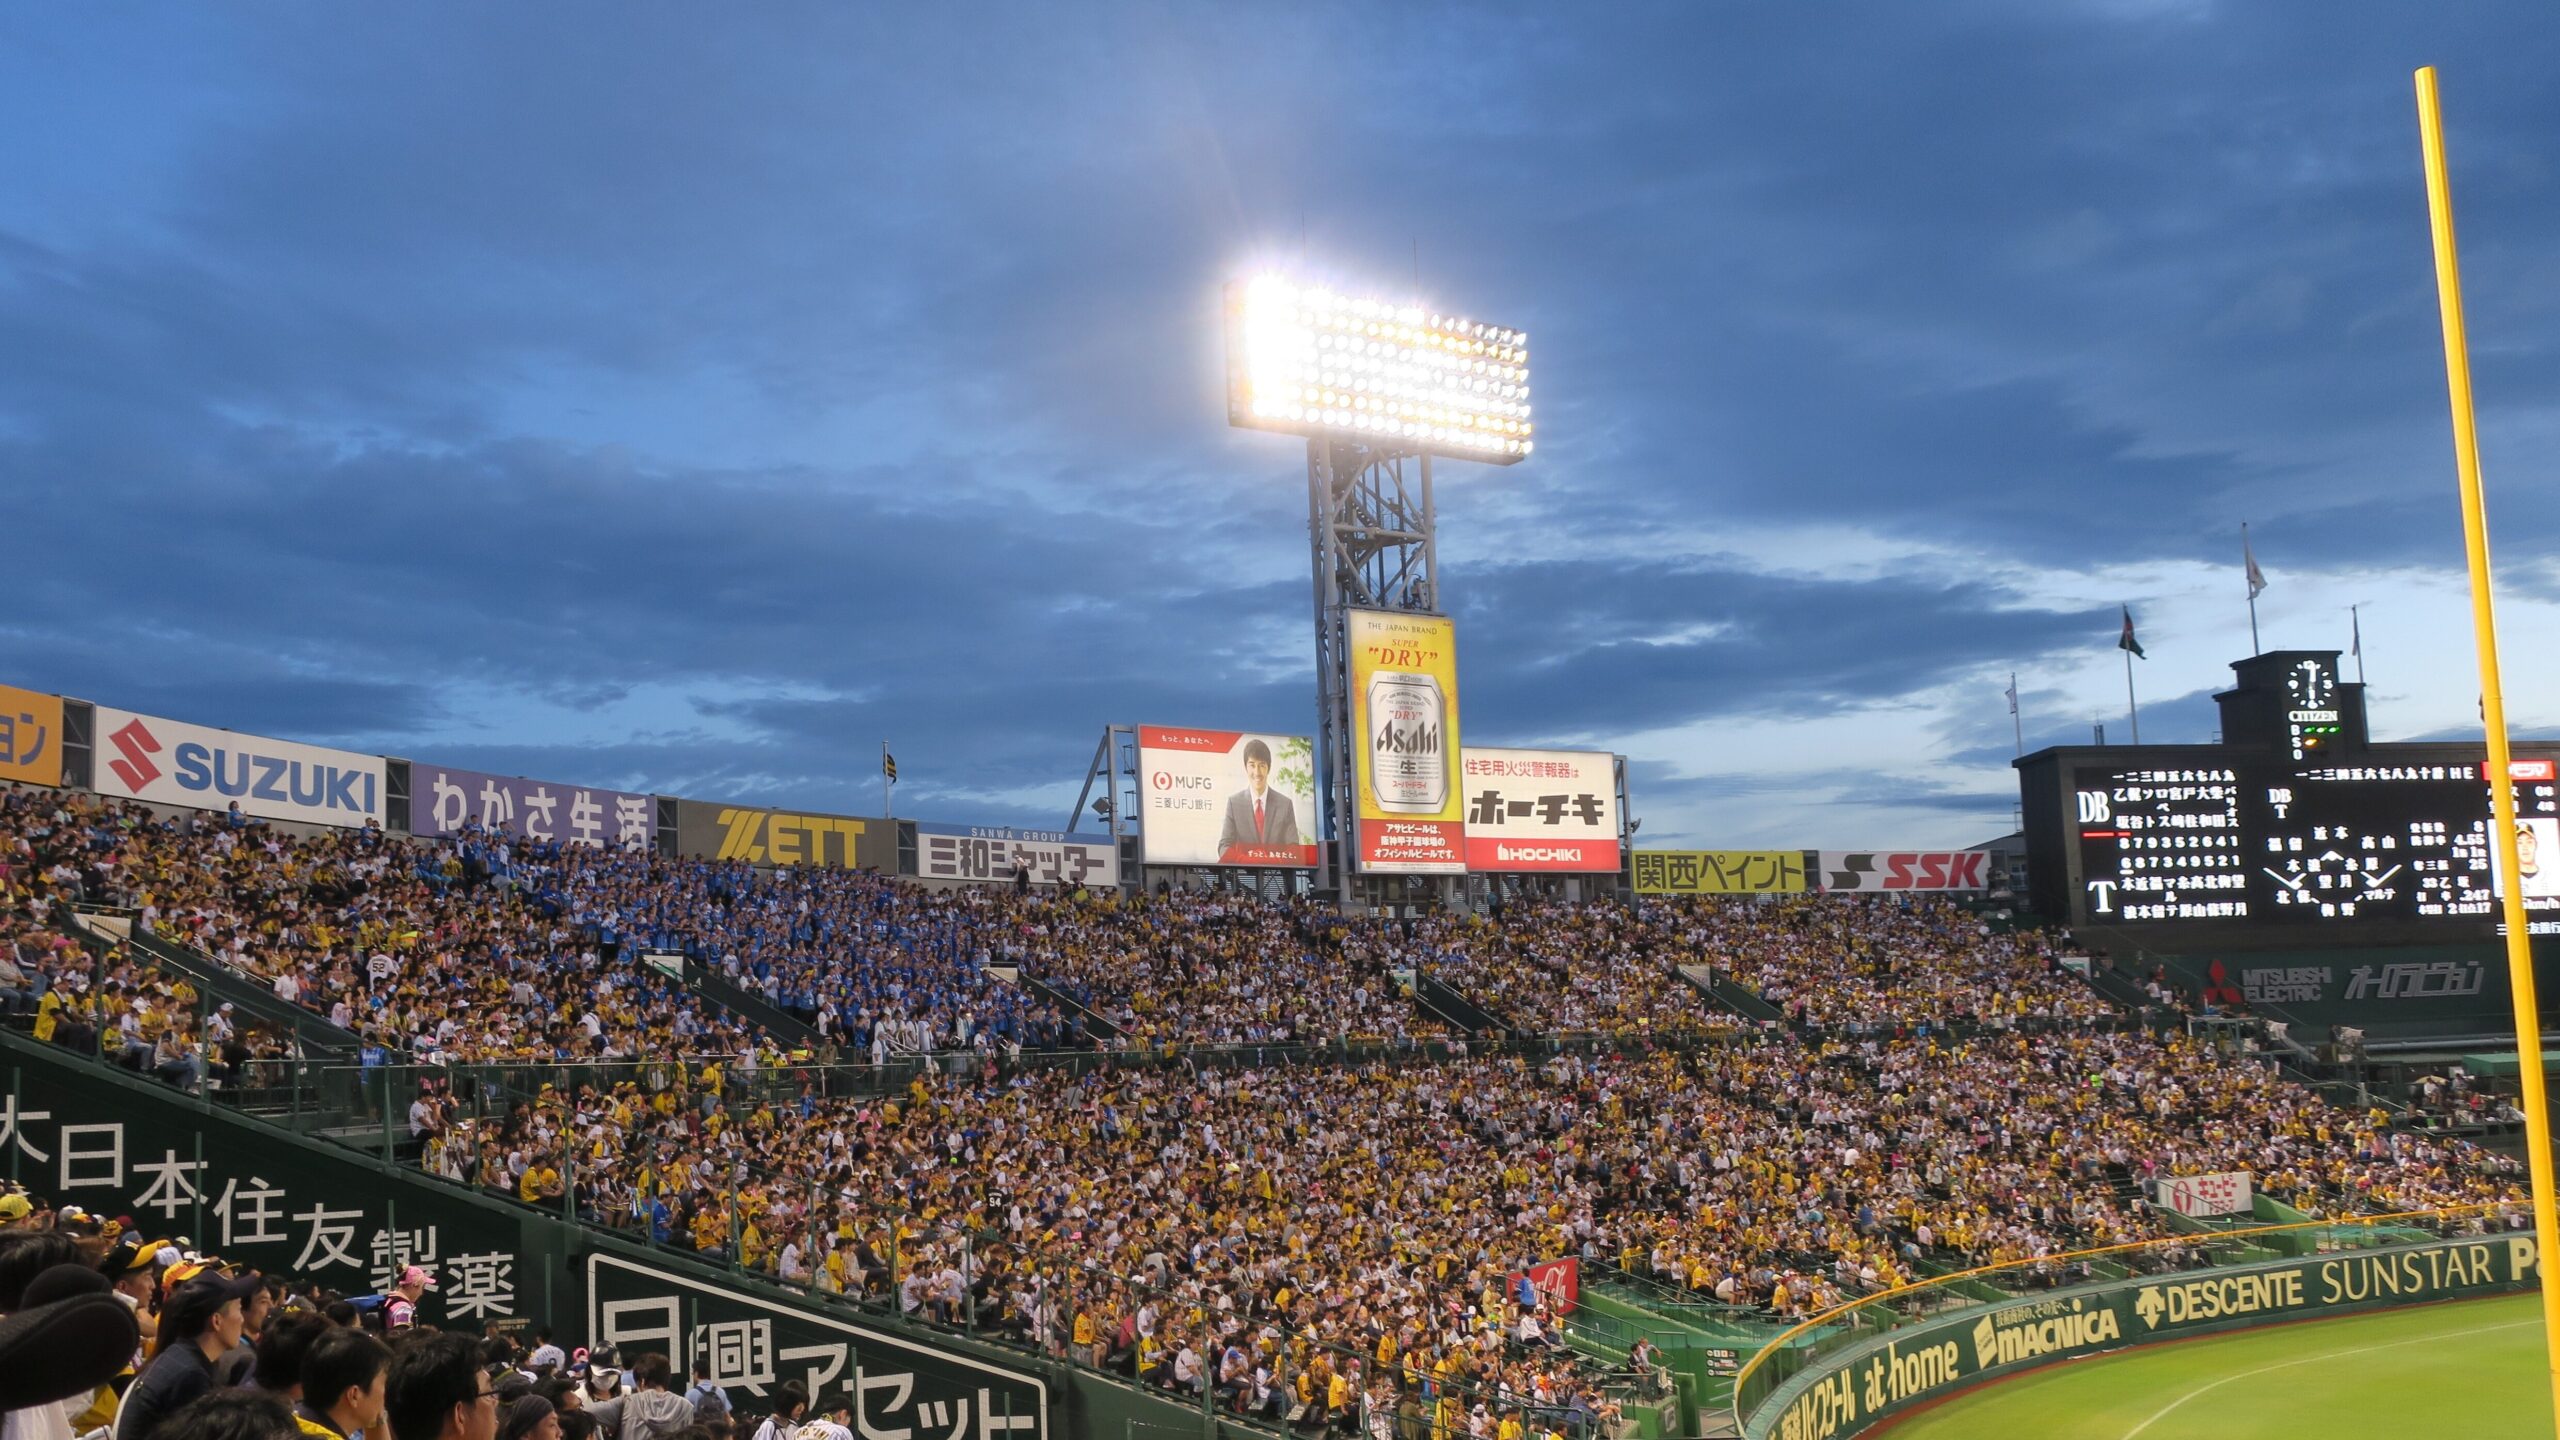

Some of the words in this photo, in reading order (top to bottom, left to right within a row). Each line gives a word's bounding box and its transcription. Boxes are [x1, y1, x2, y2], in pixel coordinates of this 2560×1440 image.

[1368, 622, 1381, 630] THE
[1385, 624, 1408, 632] JAPAN
[1412, 626, 1437, 635] BRAND
[1392, 639, 1419, 648] SUPER
[2288, 710, 2339, 722] CITIZEN
[1377, 720, 1438, 755] Asahi
[2290, 724, 2300, 736] B
[1400, 760, 1417, 775] 生
[1465, 759, 1579, 779] 住宅用火災警報器は
[174, 742, 376, 814] SUZUKI
[1175, 776, 1212, 790] MUFG
[1154, 797, 1213, 811] 三菱UFJ銀行
[2268, 789, 2292, 803] DB
[432, 773, 649, 851] わかさ生活
[1469, 790, 1604, 825] ホーチキ
[2076, 791, 2111, 823] DB
[2274, 804, 2288, 818] T
[971, 827, 1013, 840] SANWA
[1024, 831, 1065, 843] GROUP
[1386, 823, 1441, 834] アサヒビールは、
[716, 809, 865, 869] ZETT
[930, 838, 1105, 882] 三和シャッター
[1374, 848, 1455, 859] オフィシャルビールです。
[1510, 848, 1582, 862] HOCHIKI
[1635, 854, 1802, 890] 関西ペイント
[1883, 853, 1984, 889] SSK
[2469, 859, 2488, 870] 25
[2088, 880, 2117, 912] T
[372, 963, 385, 972] 52
[2241, 967, 2332, 986] MITSUBISHI
[2244, 985, 2322, 1002] ELECTRIC
[0, 1095, 514, 1321] 大日本住友製薬
[990, 1197, 1001, 1207] 94
[2509, 1238, 2541, 1280] P
[2322, 1245, 2495, 1304] SUNSTAR
[2167, 1270, 2304, 1323] DESCENTE
[603, 1295, 1034, 1440] 日興アセット
[1865, 1357, 1886, 1413] at
[1887, 1342, 1958, 1401] home
